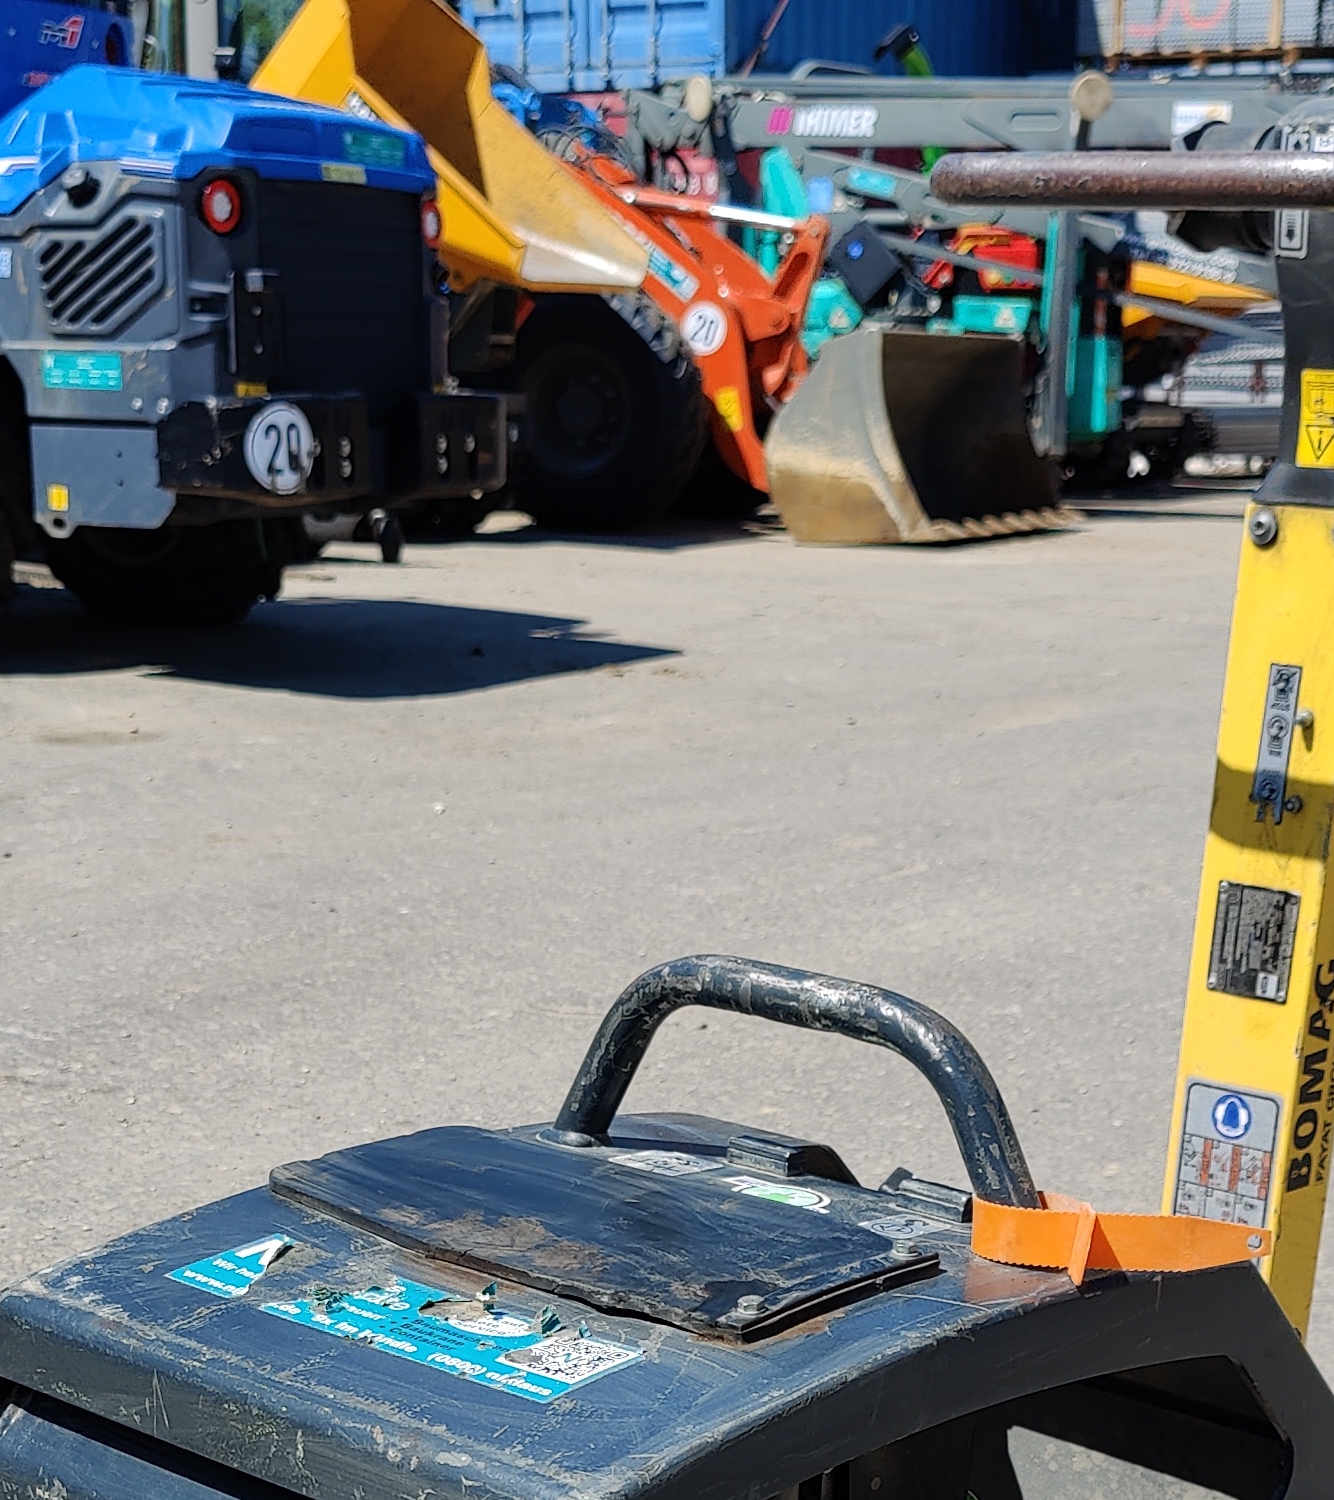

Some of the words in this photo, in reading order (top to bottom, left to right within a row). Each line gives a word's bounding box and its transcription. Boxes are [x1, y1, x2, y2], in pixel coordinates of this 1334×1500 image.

[690, 312, 718, 347] 20
[263, 424, 300, 475] 20
[1314, 1114, 1334, 1187] FAYAT
